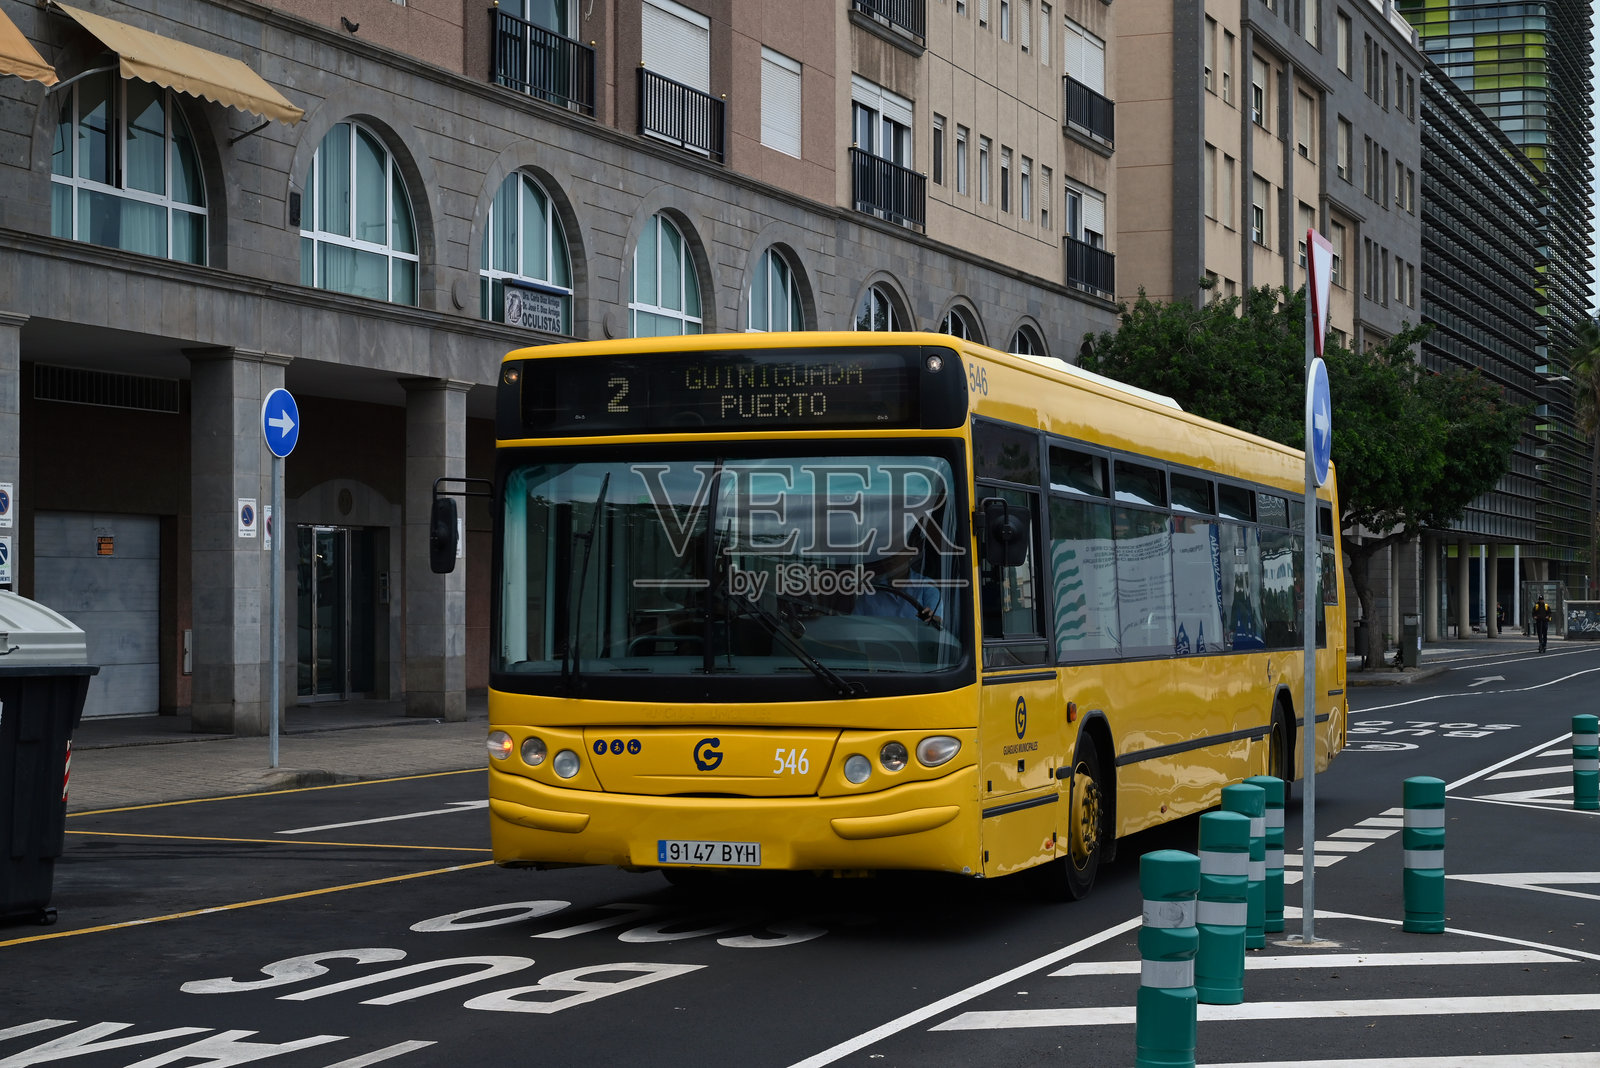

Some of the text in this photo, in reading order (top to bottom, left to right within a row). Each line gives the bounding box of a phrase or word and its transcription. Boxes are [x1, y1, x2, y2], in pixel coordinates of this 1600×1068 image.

[523, 312, 560, 333] OCULISTAS
[685, 364, 863, 390] GUINIGUADA
[968, 362, 989, 397] 546
[607, 377, 629, 413] 2
[721, 392, 827, 418] PUERTO
[1018, 741, 1038, 752] MUNICIPALES
[773, 747, 810, 775] 546
[670, 842, 756, 863] 9147 BYH
[180, 947, 707, 1014] BUS
